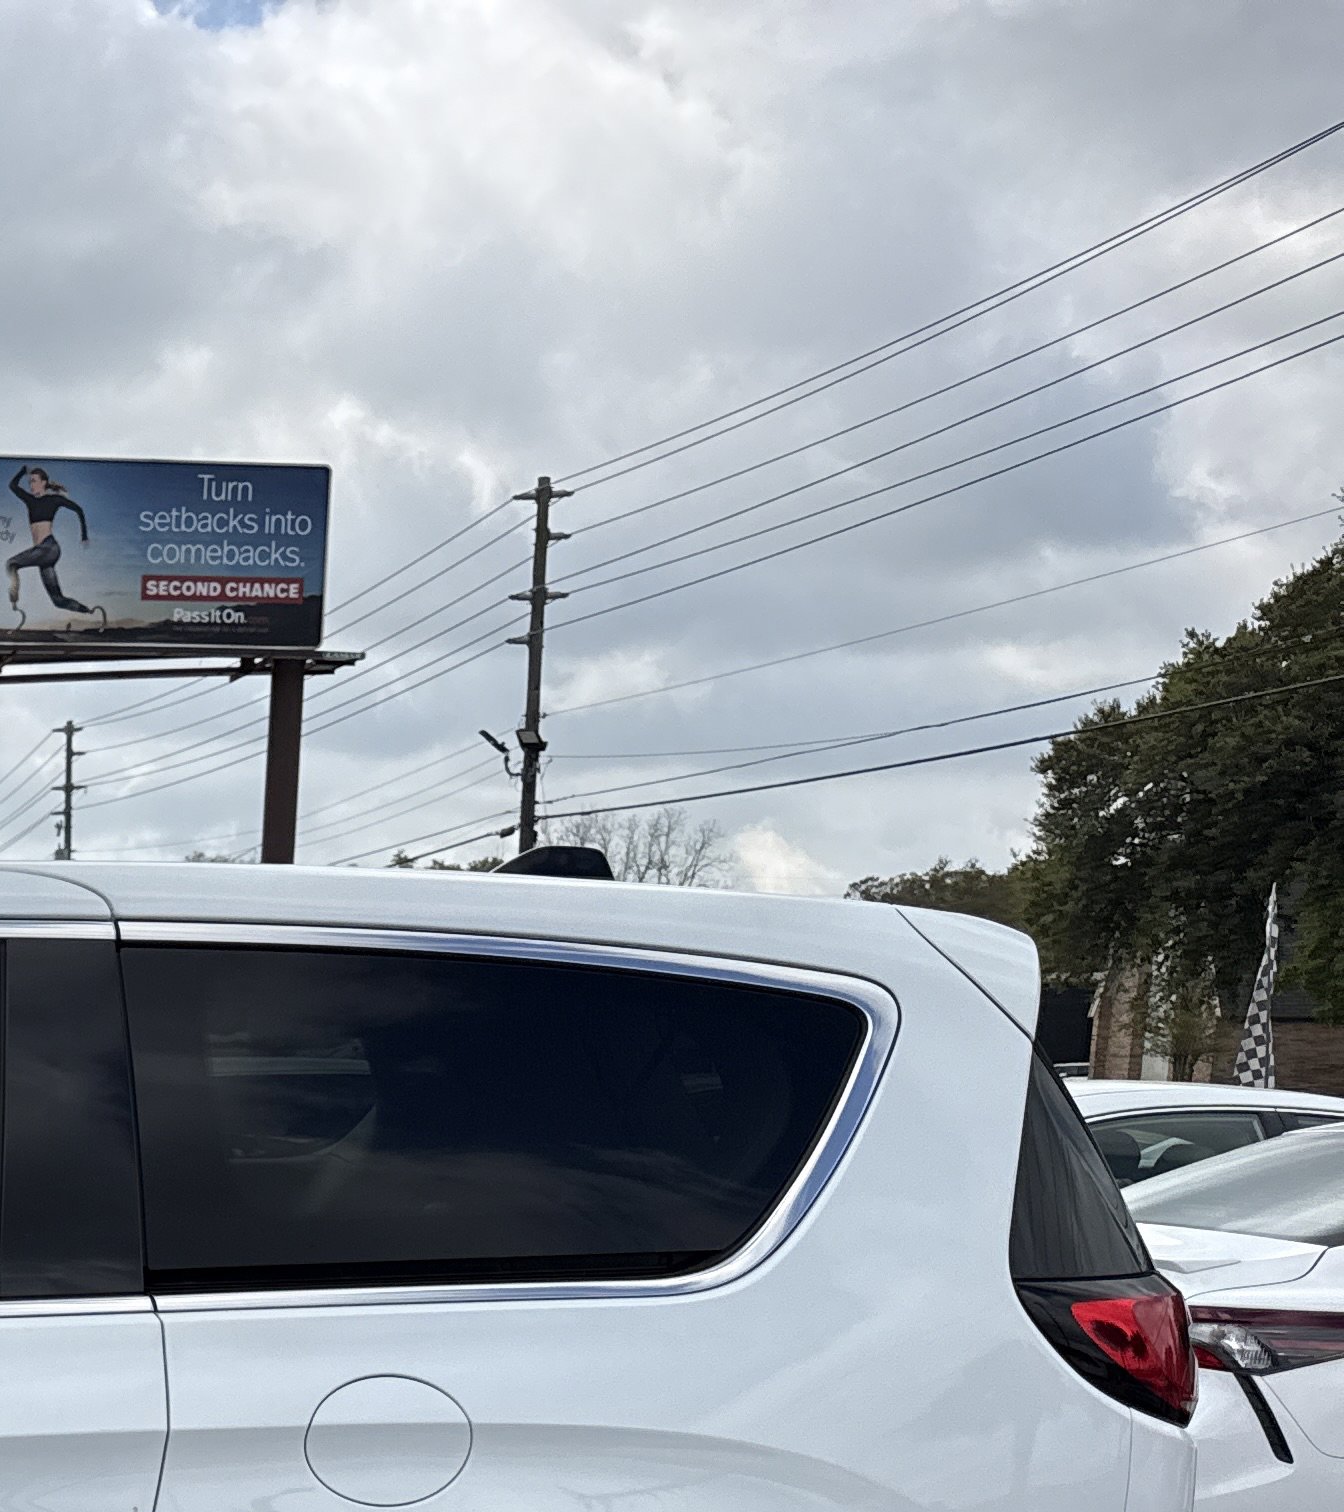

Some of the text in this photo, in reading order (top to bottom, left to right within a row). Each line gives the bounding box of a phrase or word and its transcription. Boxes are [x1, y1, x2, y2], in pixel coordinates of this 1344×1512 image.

[197, 473, 253, 502] Turn
[138, 506, 312, 536] setbacks into
[146, 539, 305, 568] comebacks.
[145, 580, 300, 599] SECOND CHANCE
